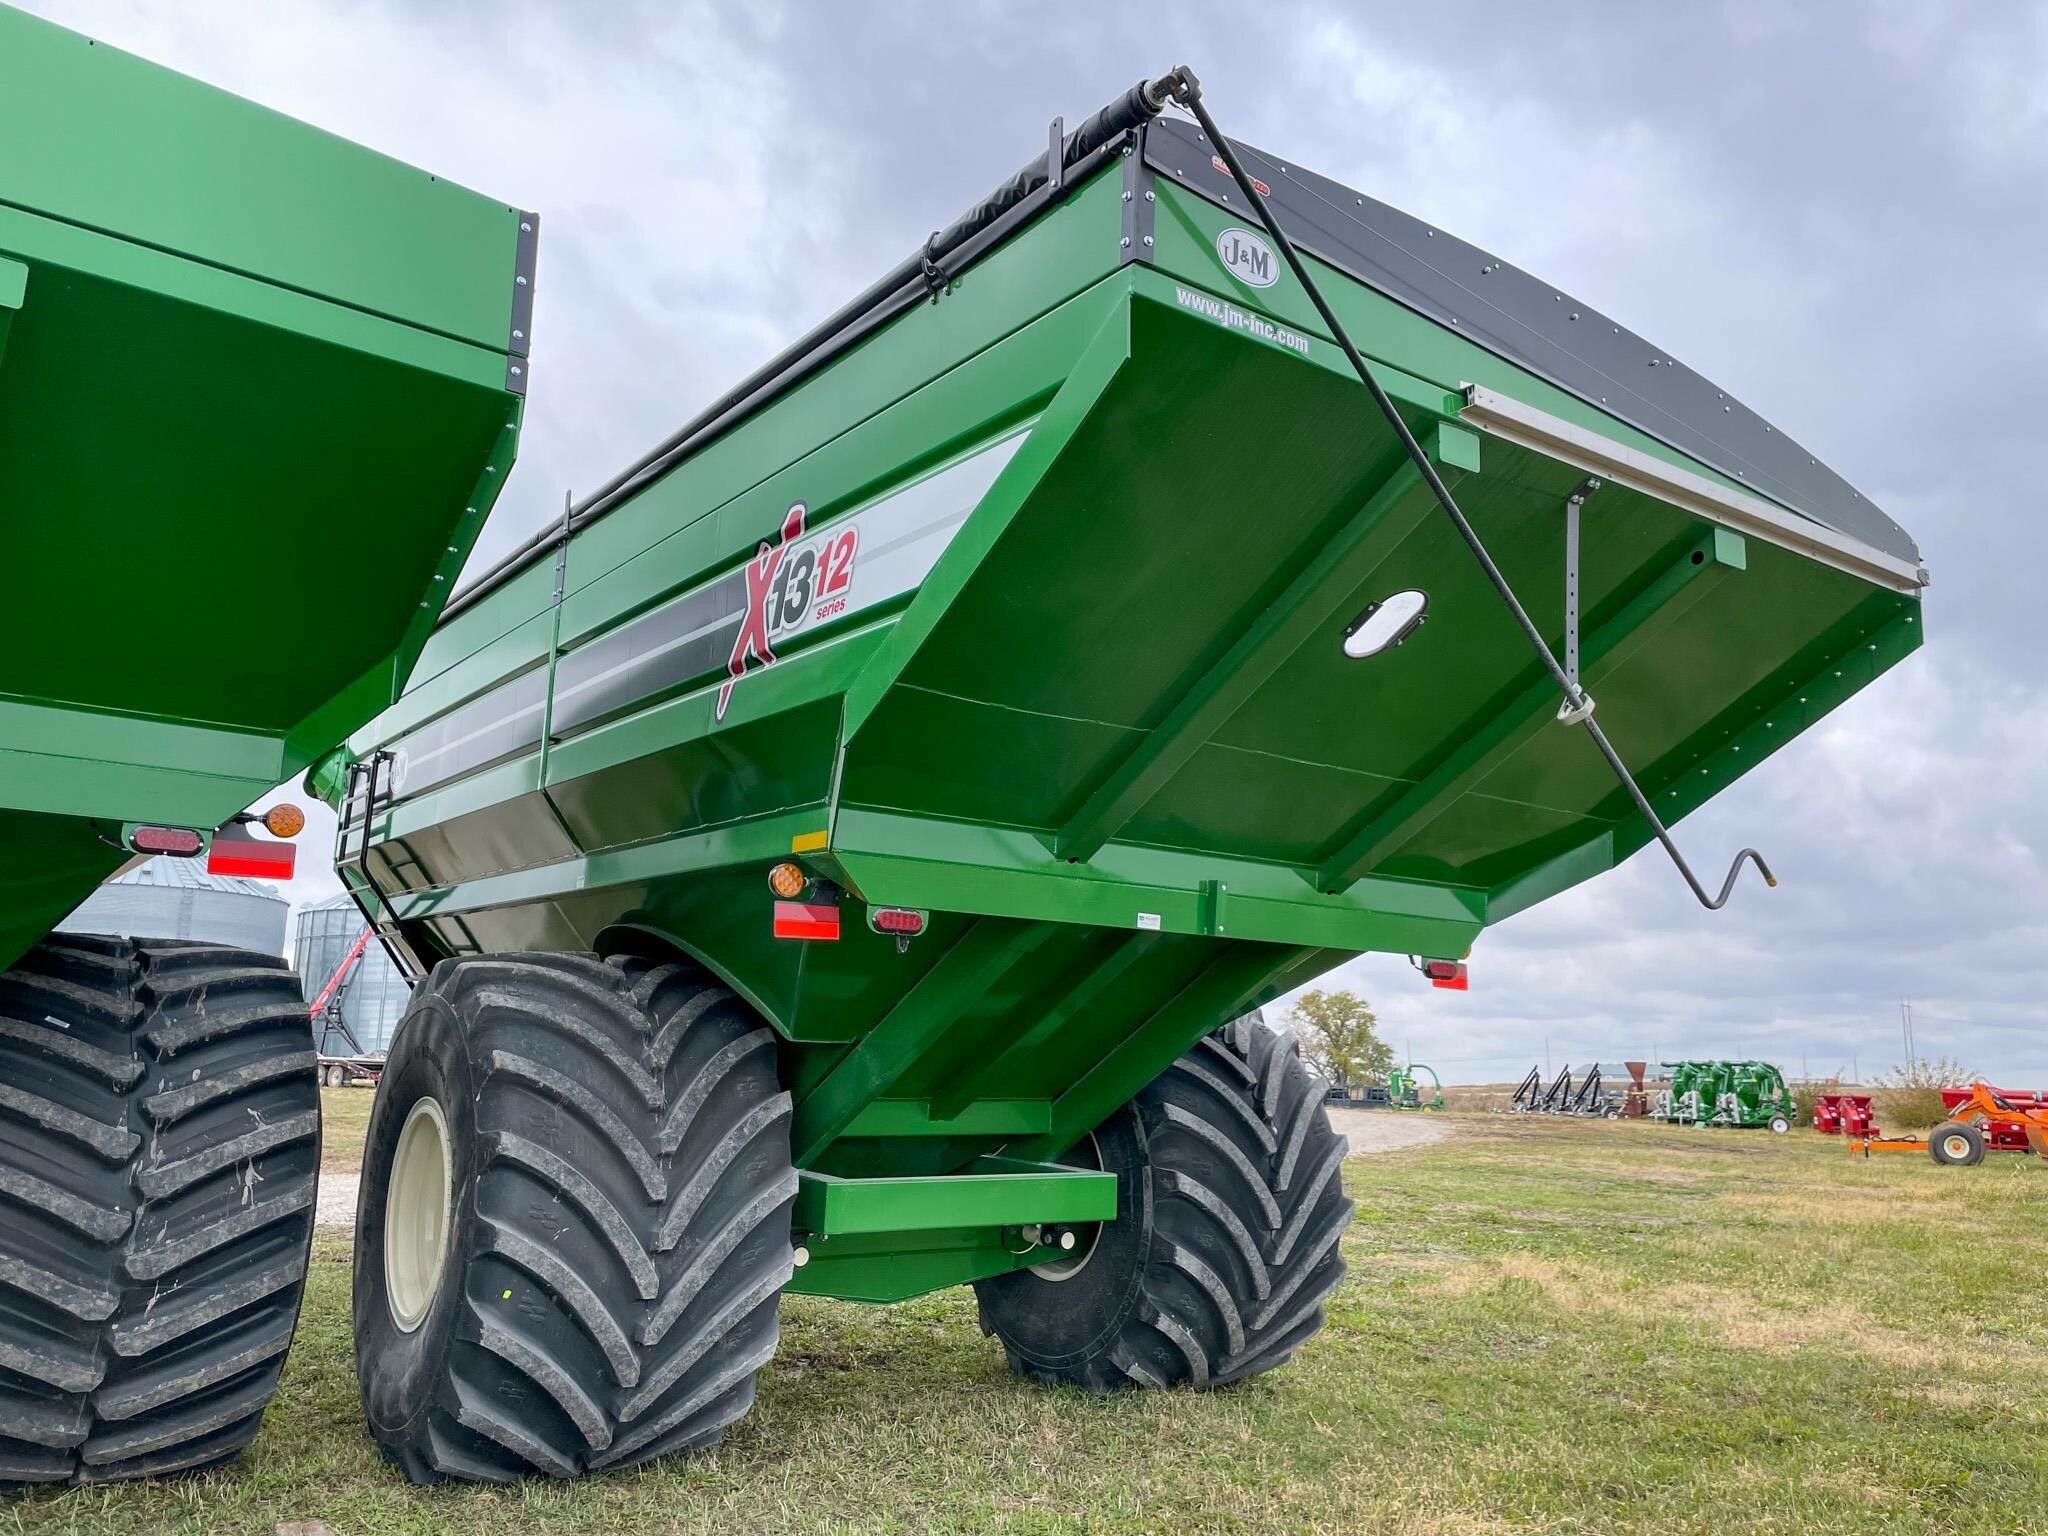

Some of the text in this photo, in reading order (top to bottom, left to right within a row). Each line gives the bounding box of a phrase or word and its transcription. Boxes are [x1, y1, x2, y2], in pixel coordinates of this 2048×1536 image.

[1224, 238, 1270, 280] J&M
[1175, 286, 1309, 354] www.jm-inc.com
[815, 597, 846, 621] series
